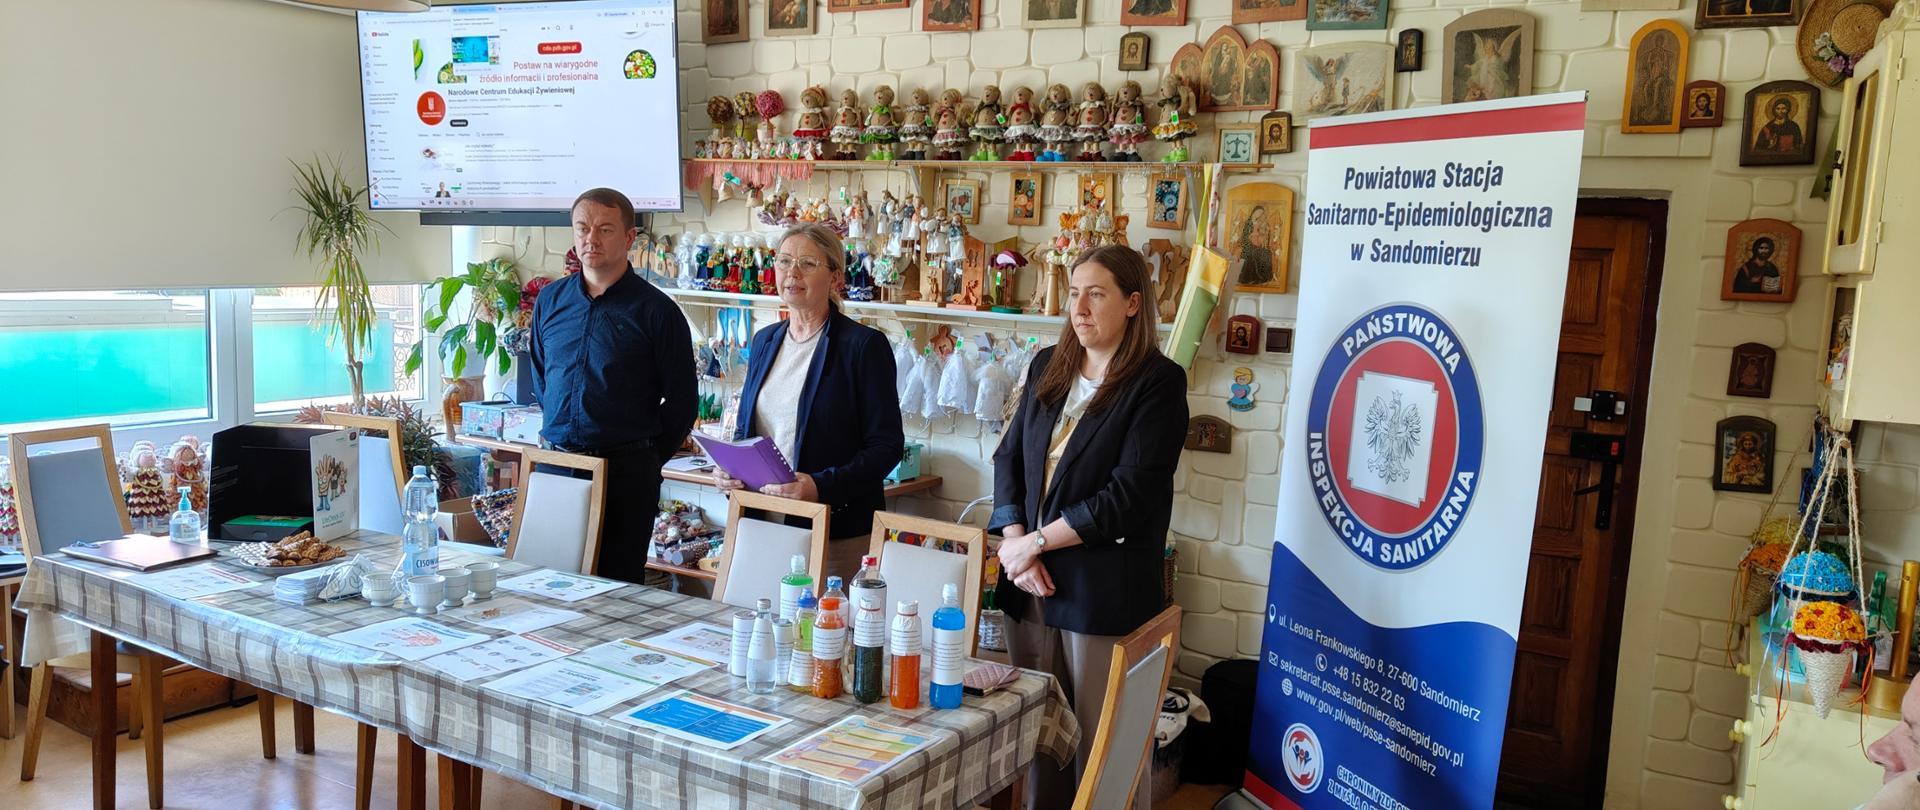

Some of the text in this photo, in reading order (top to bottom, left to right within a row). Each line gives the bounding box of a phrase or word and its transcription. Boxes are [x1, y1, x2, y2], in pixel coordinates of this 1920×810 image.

[513, 61, 541, 69] Postaw
[555, 59, 598, 70] wiarygodne
[448, 88, 479, 96] Narodowe
[508, 87, 534, 96] Edukacji
[536, 86, 575, 95] Żywieniowej
[1344, 160, 1504, 192] Powiatowa Stacja
[1307, 201, 1553, 233] Sanitarno-Epidemiologiczna
[1351, 238, 1481, 267] w Sandomierzu
[1342, 313, 1461, 375] PAŃSTWOWA
[1310, 432, 1475, 564] INSPEKCJA SANITARNA
[1279, 615, 1481, 722] ul. Leona Frankowskiego 8, 27-600 Sandomierz
[1333, 665, 1406, 711] +48 15 832 22 63
[1280, 657, 1465, 768] sekretariat.psse.sandomierz@sanepid.gov.pl
[1296, 687, 1438, 777] www.gov.pl/web/psse-sandomierz
[1328, 778, 1335, 794] Z
[1337, 765, 1380, 803] CHRONIMY
